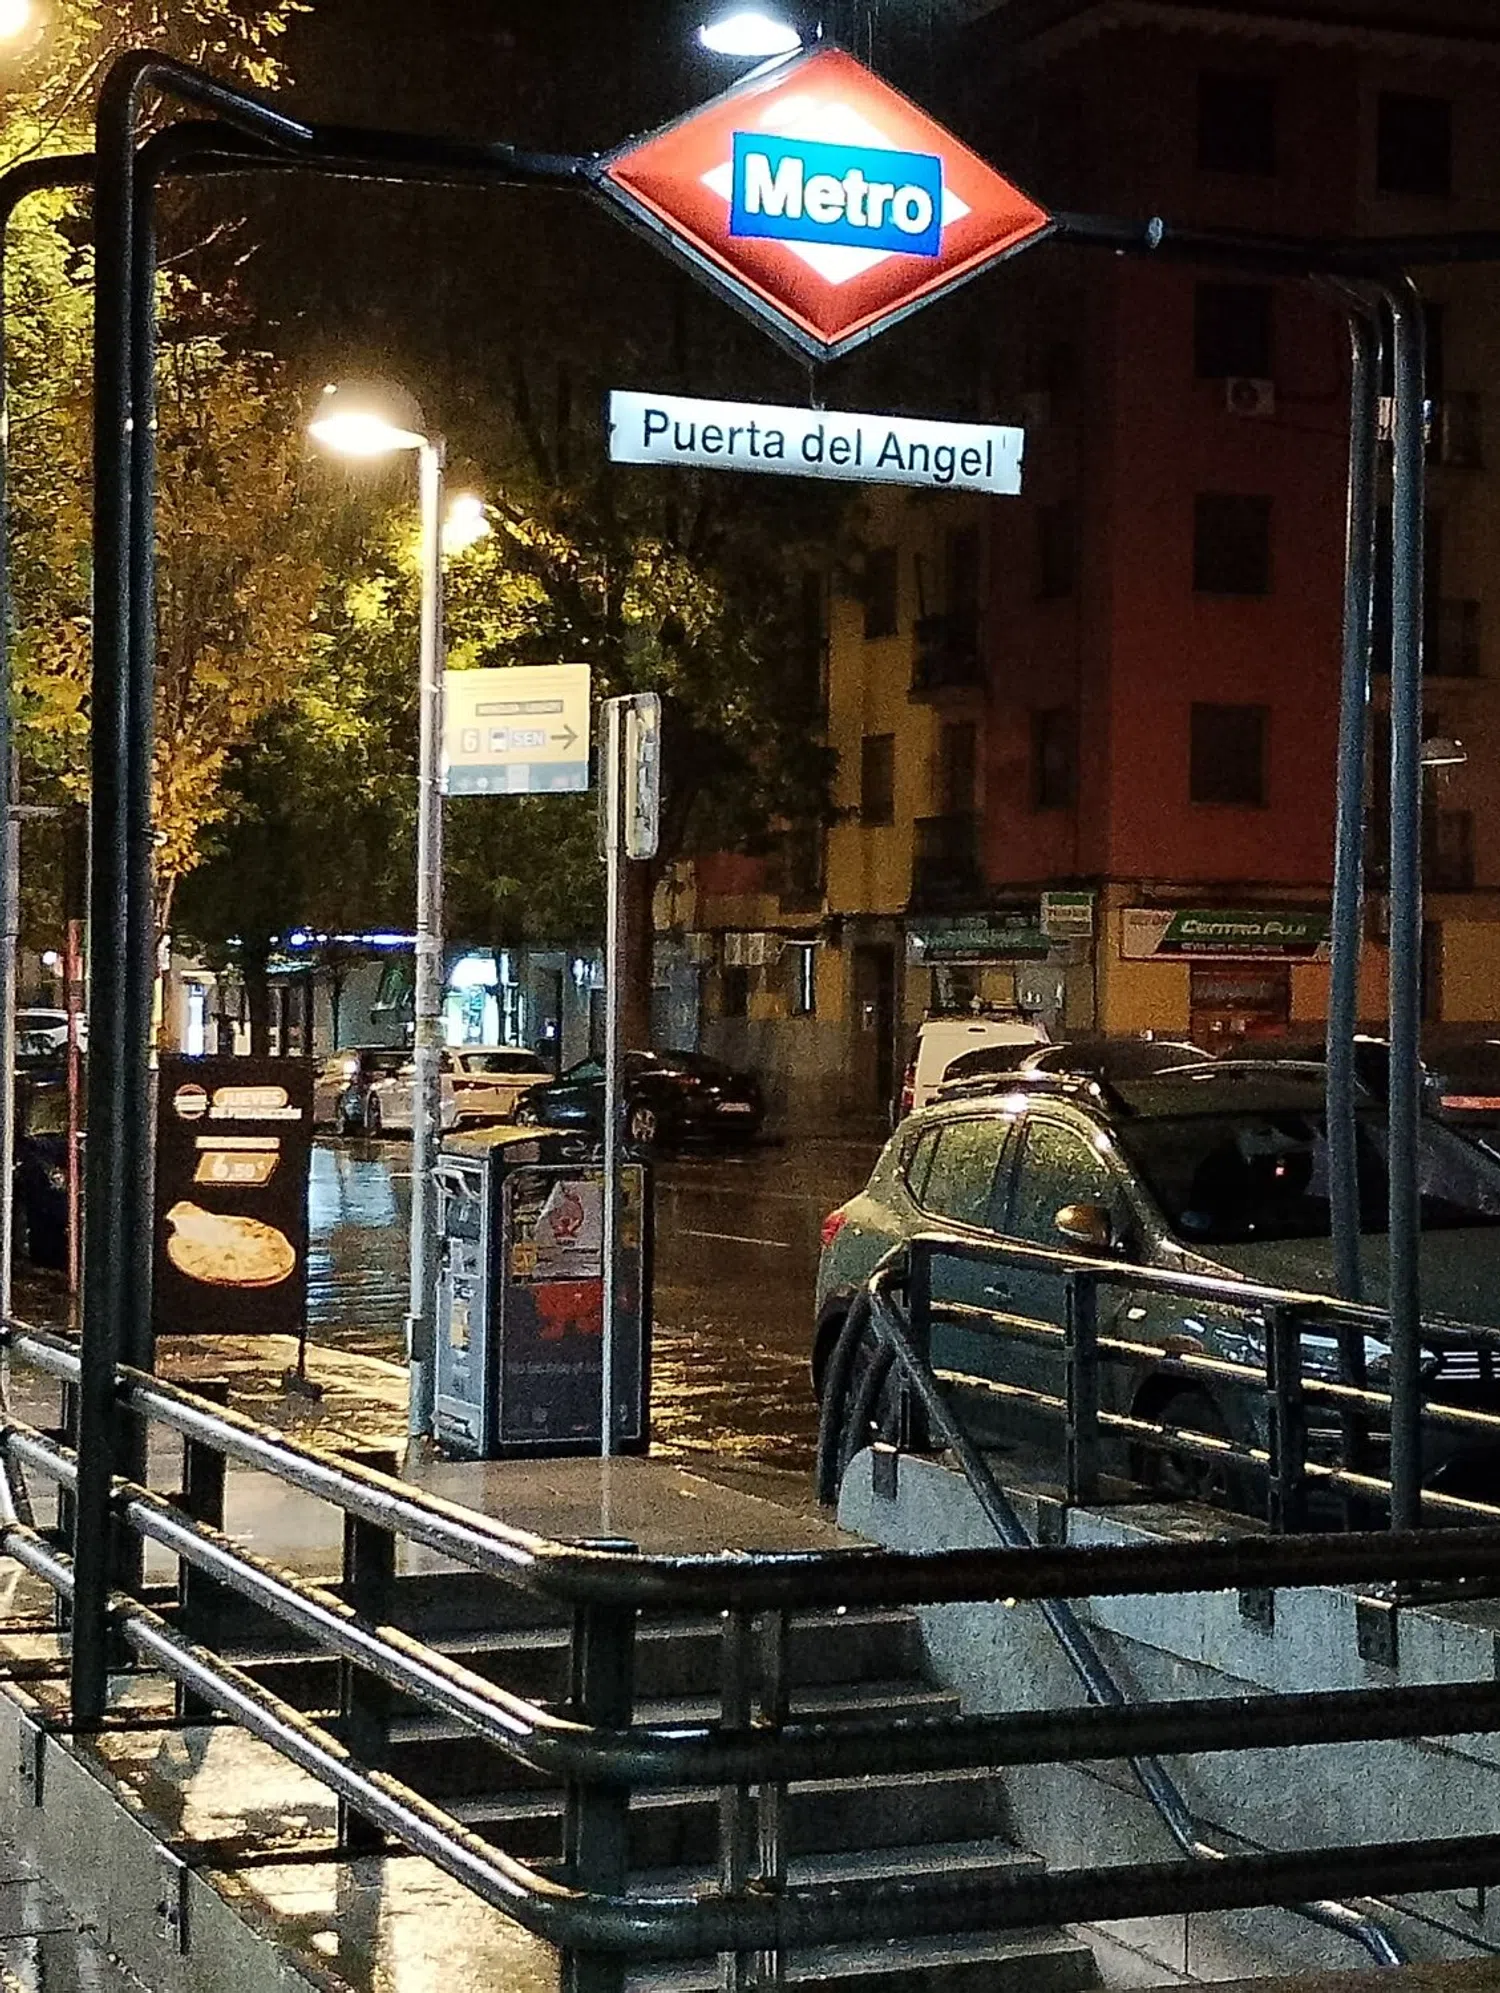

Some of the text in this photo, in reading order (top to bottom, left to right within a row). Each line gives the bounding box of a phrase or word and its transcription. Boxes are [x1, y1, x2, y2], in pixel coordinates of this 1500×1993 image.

[745, 152, 933, 234] Metro
[644, 409, 992, 483] Puerta del Angel
